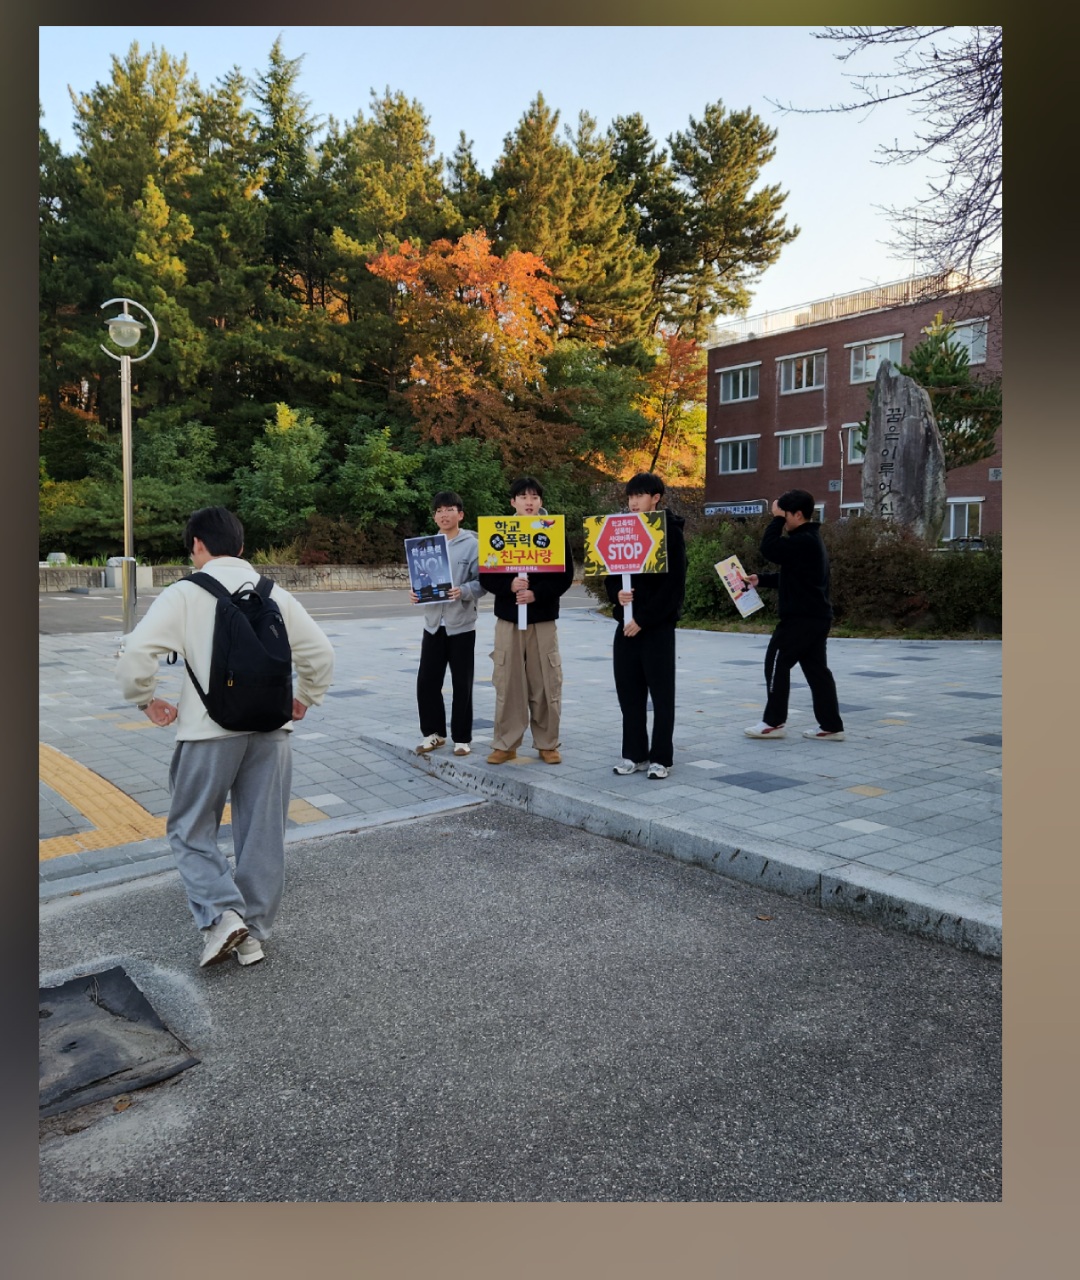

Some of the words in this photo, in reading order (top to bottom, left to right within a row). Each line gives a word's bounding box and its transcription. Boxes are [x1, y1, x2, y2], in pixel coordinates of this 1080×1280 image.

[494, 521, 521, 534] 학교
[504, 533, 531, 548] 폭력
[500, 549, 552, 563] 친구사랑
[608, 542, 643, 560] STOP
